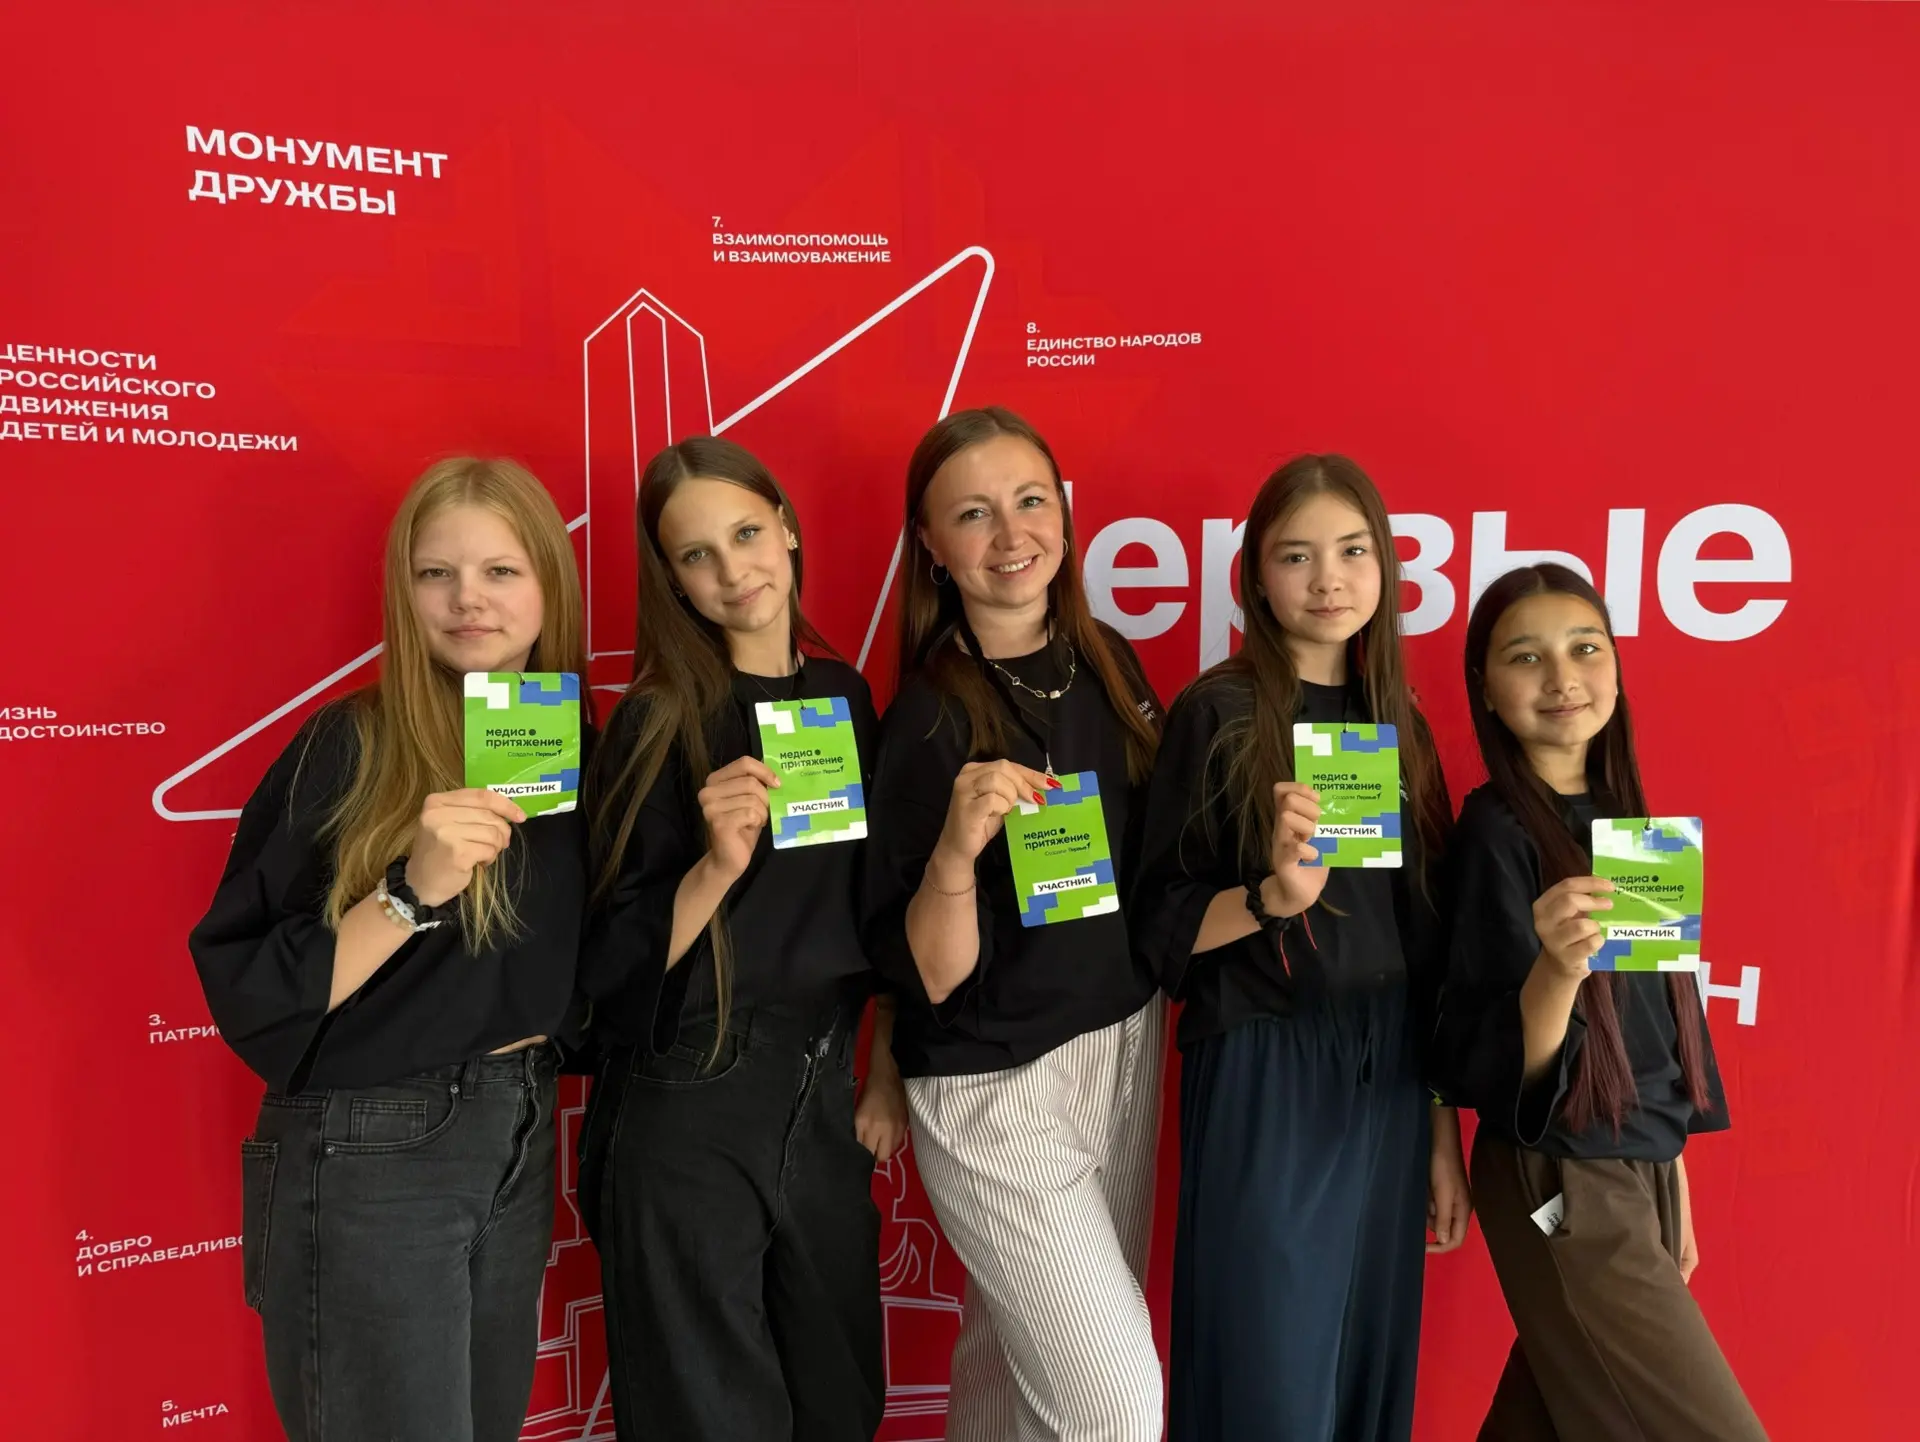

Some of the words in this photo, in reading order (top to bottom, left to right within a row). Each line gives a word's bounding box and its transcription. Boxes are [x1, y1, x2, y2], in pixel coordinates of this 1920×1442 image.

[185, 125, 448, 179] МОНУМЕНТ
[187, 169, 396, 216] ДРУЖБЫ
[711, 215, 724, 228] 7.
[712, 233, 889, 248] ВЗАИМОПОПОМОЩЬ
[713, 250, 725, 262] И
[728, 250, 891, 264] ВЗАИМОУВАЖЕНИЕ
[1026, 321, 1040, 334] 8.
[1027, 336, 1117, 353] ЕДИНСТВО
[1119, 332, 1202, 347] НАРОДОВ
[0, 343, 157, 371] ЦЕННОСТИ
[1027, 354, 1095, 368] РОССИИ
[0, 368, 216, 399] РОССИЙСКОГО
[0, 394, 169, 421] ДВИЖЕНИЯ
[0, 420, 98, 442] ДЕТЕЙ
[105, 426, 125, 444] И
[131, 428, 298, 452] МОЛОДЕЖИ
[0, 721, 166, 742] ДОСТОИНСТВО
[486, 728, 526, 738] медиа
[486, 738, 563, 749] притяжение
[780, 749, 813, 760] медиа
[781, 756, 843, 770] притяжение
[1312, 773, 1349, 782] медиа
[493, 784, 556, 794] УЧАСТНИК
[1312, 783, 1382, 792] притяжение
[792, 801, 844, 813] УЧАСТНИК
[1023, 829, 1058, 840] медиа
[1319, 827, 1377, 836] УЧАСТНИК
[1025, 833, 1090, 851] притяжение
[1038, 876, 1092, 892] УЧАСТНИК
[1610, 875, 1650, 885] медиа
[1614, 884, 1685, 895] ритяжение
[1613, 929, 1675, 938] УЧАСТНИК
[148, 1013, 166, 1026] 3.
[75, 1229, 94, 1241] 4.
[76, 1235, 152, 1262] ДОБРО
[78, 1263, 92, 1277] И
[162, 1399, 178, 1412] 5.
[162, 1403, 229, 1428] МЕЧТА
